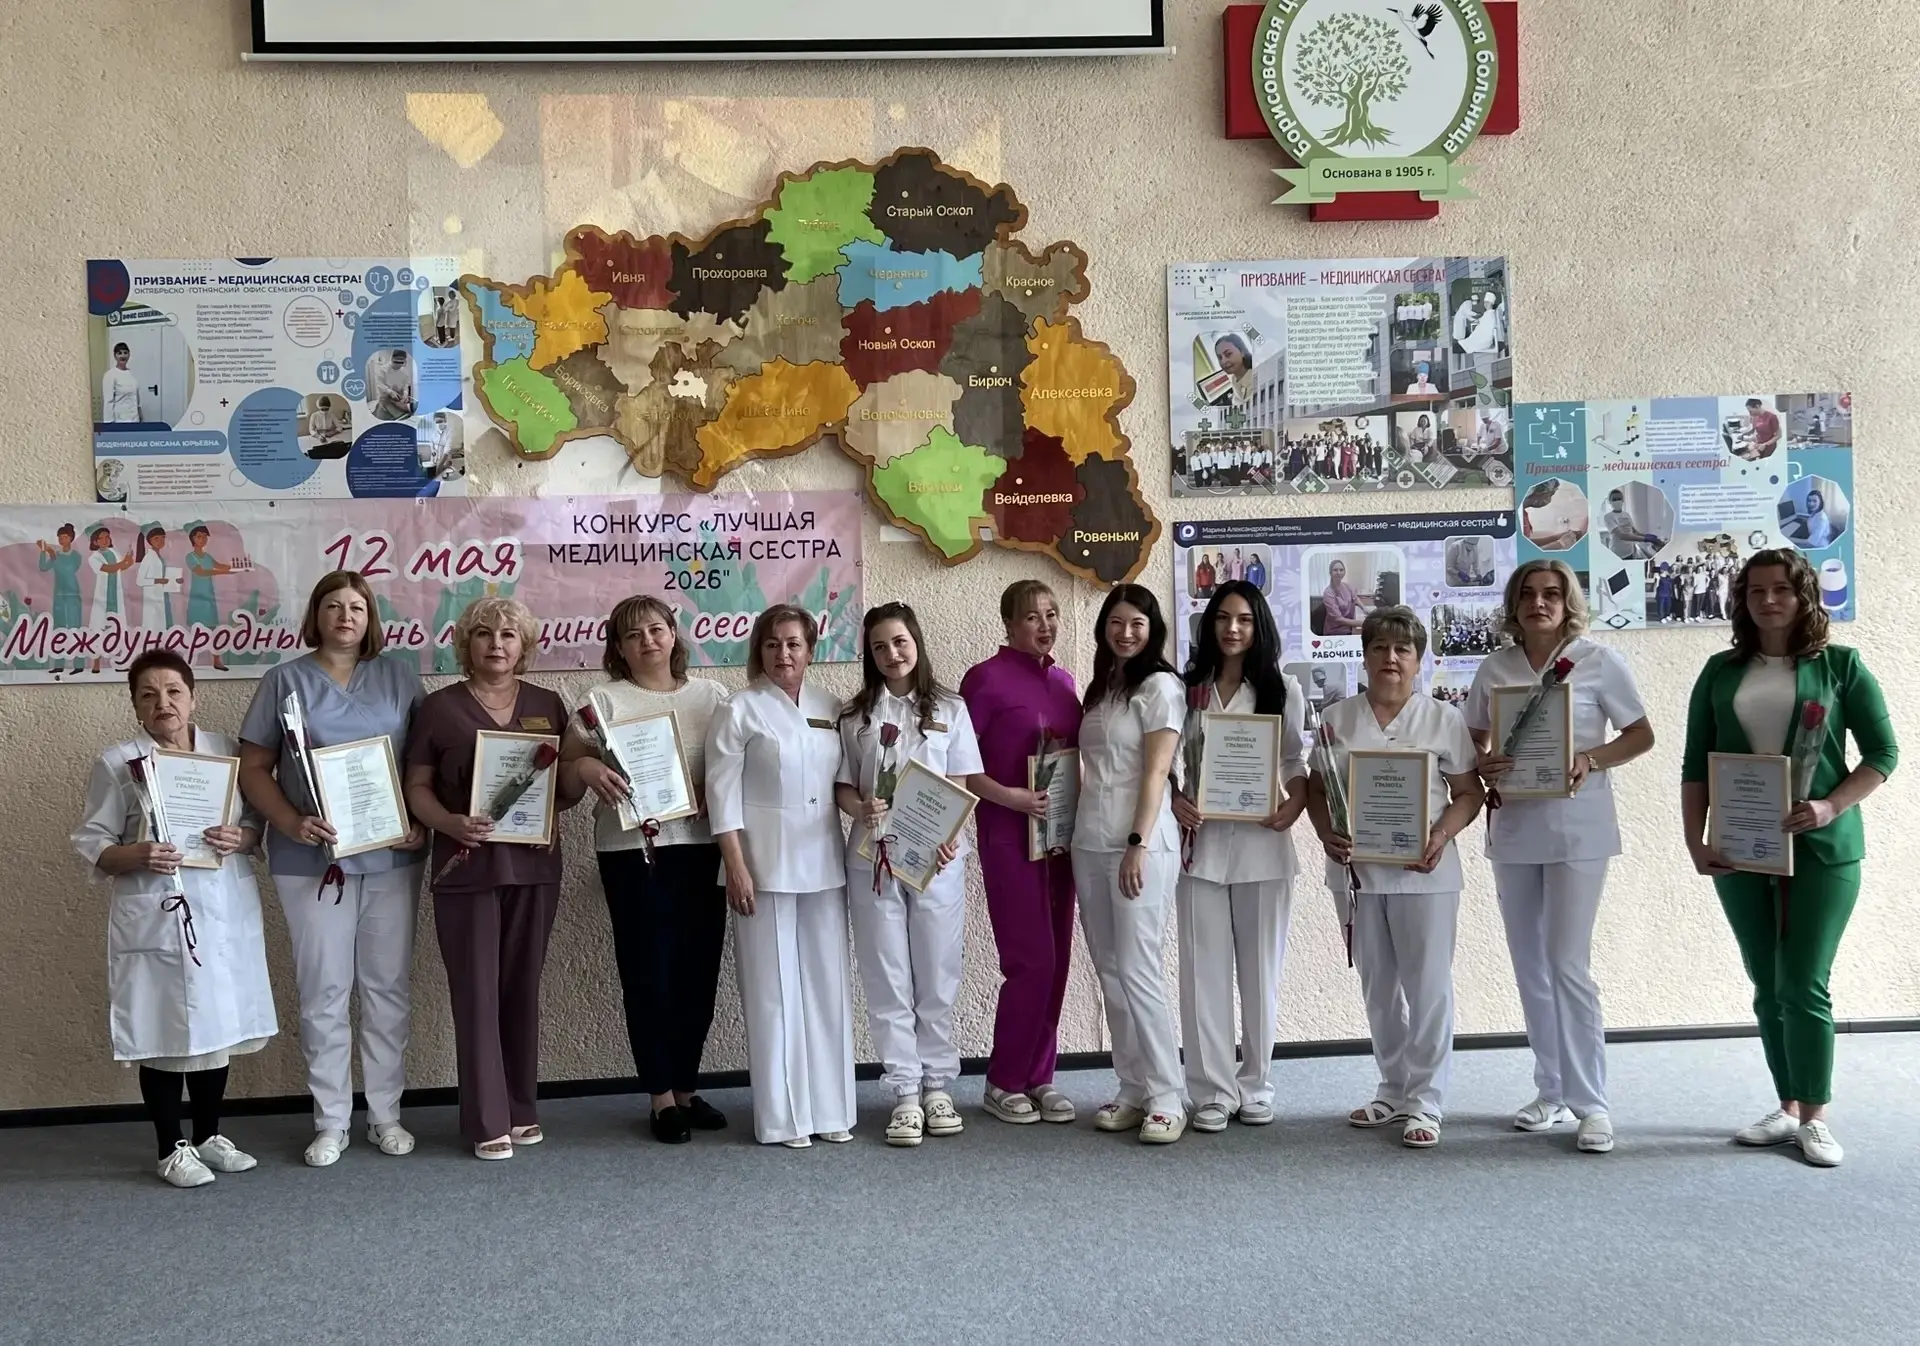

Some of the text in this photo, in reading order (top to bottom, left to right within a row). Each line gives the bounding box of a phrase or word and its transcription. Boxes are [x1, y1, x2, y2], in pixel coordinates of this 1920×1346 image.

[1262, 18, 1312, 159] Борисовская
[1442, 50, 1495, 154] больница
[1322, 168, 1382, 179] Основана
[1396, 166, 1424, 177] 1905
[1427, 168, 1434, 176] г.
[887, 204, 973, 219] Старый Оскол
[134, 276, 206, 285] ПРИЗВАНИЕ
[218, 276, 309, 286] МЕДИЦИНСКАЯ
[311, 275, 362, 284] СЕСТРА!
[612, 272, 645, 285] Ивня
[692, 267, 767, 281] Прохоровка
[869, 268, 928, 281] Чернянка
[1240, 273, 1306, 287] ПРИЗВАНИЕ
[1320, 271, 1400, 287] МЕДИЦИНСКАЯ
[1403, 269, 1447, 284] СЕСТРА!
[1006, 276, 1055, 289] Красное
[858, 338, 935, 351] Новый Оскол
[554, 365, 608, 413] Борисовка
[969, 375, 1012, 389] Бирюч
[1031, 387, 1112, 400] Алексеевка
[861, 409, 947, 421] Волоконовка
[1525, 462, 1590, 476] Призвание
[1602, 460, 1681, 473] медицинская
[1685, 456, 1731, 470] сестра!
[995, 492, 1072, 506] Вейделевка
[573, 512, 815, 534] КОНКУРС «ЛУЧШАЯ
[1337, 521, 1388, 532] Призвание
[1398, 519, 1459, 530] медицинская
[1461, 518, 1495, 528] сестра!
[1074, 530, 1139, 544] Ровеньки
[325, 534, 516, 577] 12 мая
[548, 538, 841, 566] МЕДИЦИНСКАЯ СЕСТРА
[664, 570, 730, 590] 2026"
[4, 613, 302, 665] Международны
[384, 624, 424, 647] нь
